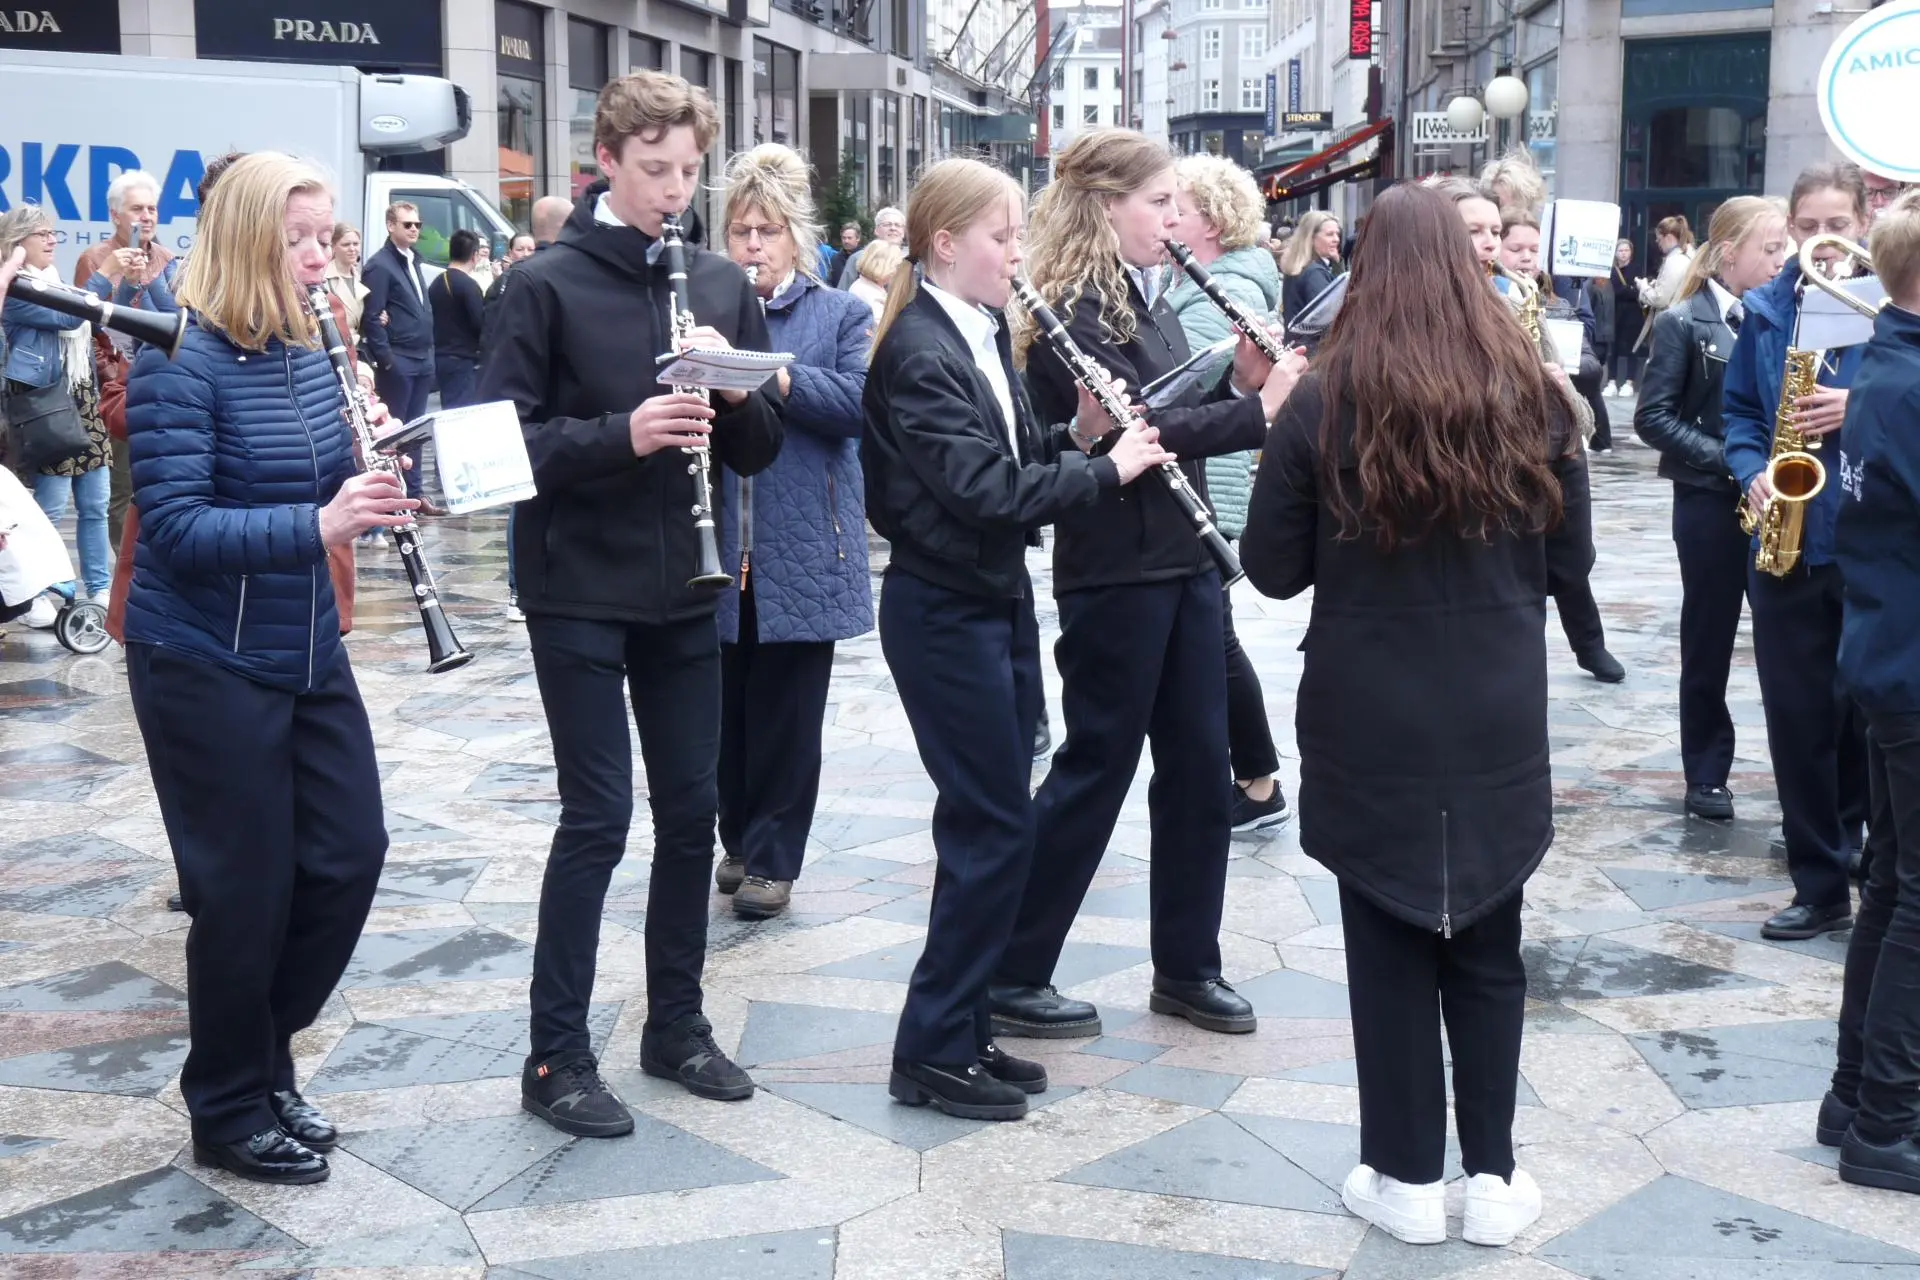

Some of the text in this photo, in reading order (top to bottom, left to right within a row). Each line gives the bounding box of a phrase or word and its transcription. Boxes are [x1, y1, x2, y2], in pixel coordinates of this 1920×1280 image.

[273, 18, 380, 44] PRADA
[1352, 21, 1370, 53] ROSA
[1286, 113, 1321, 122] STENDER
